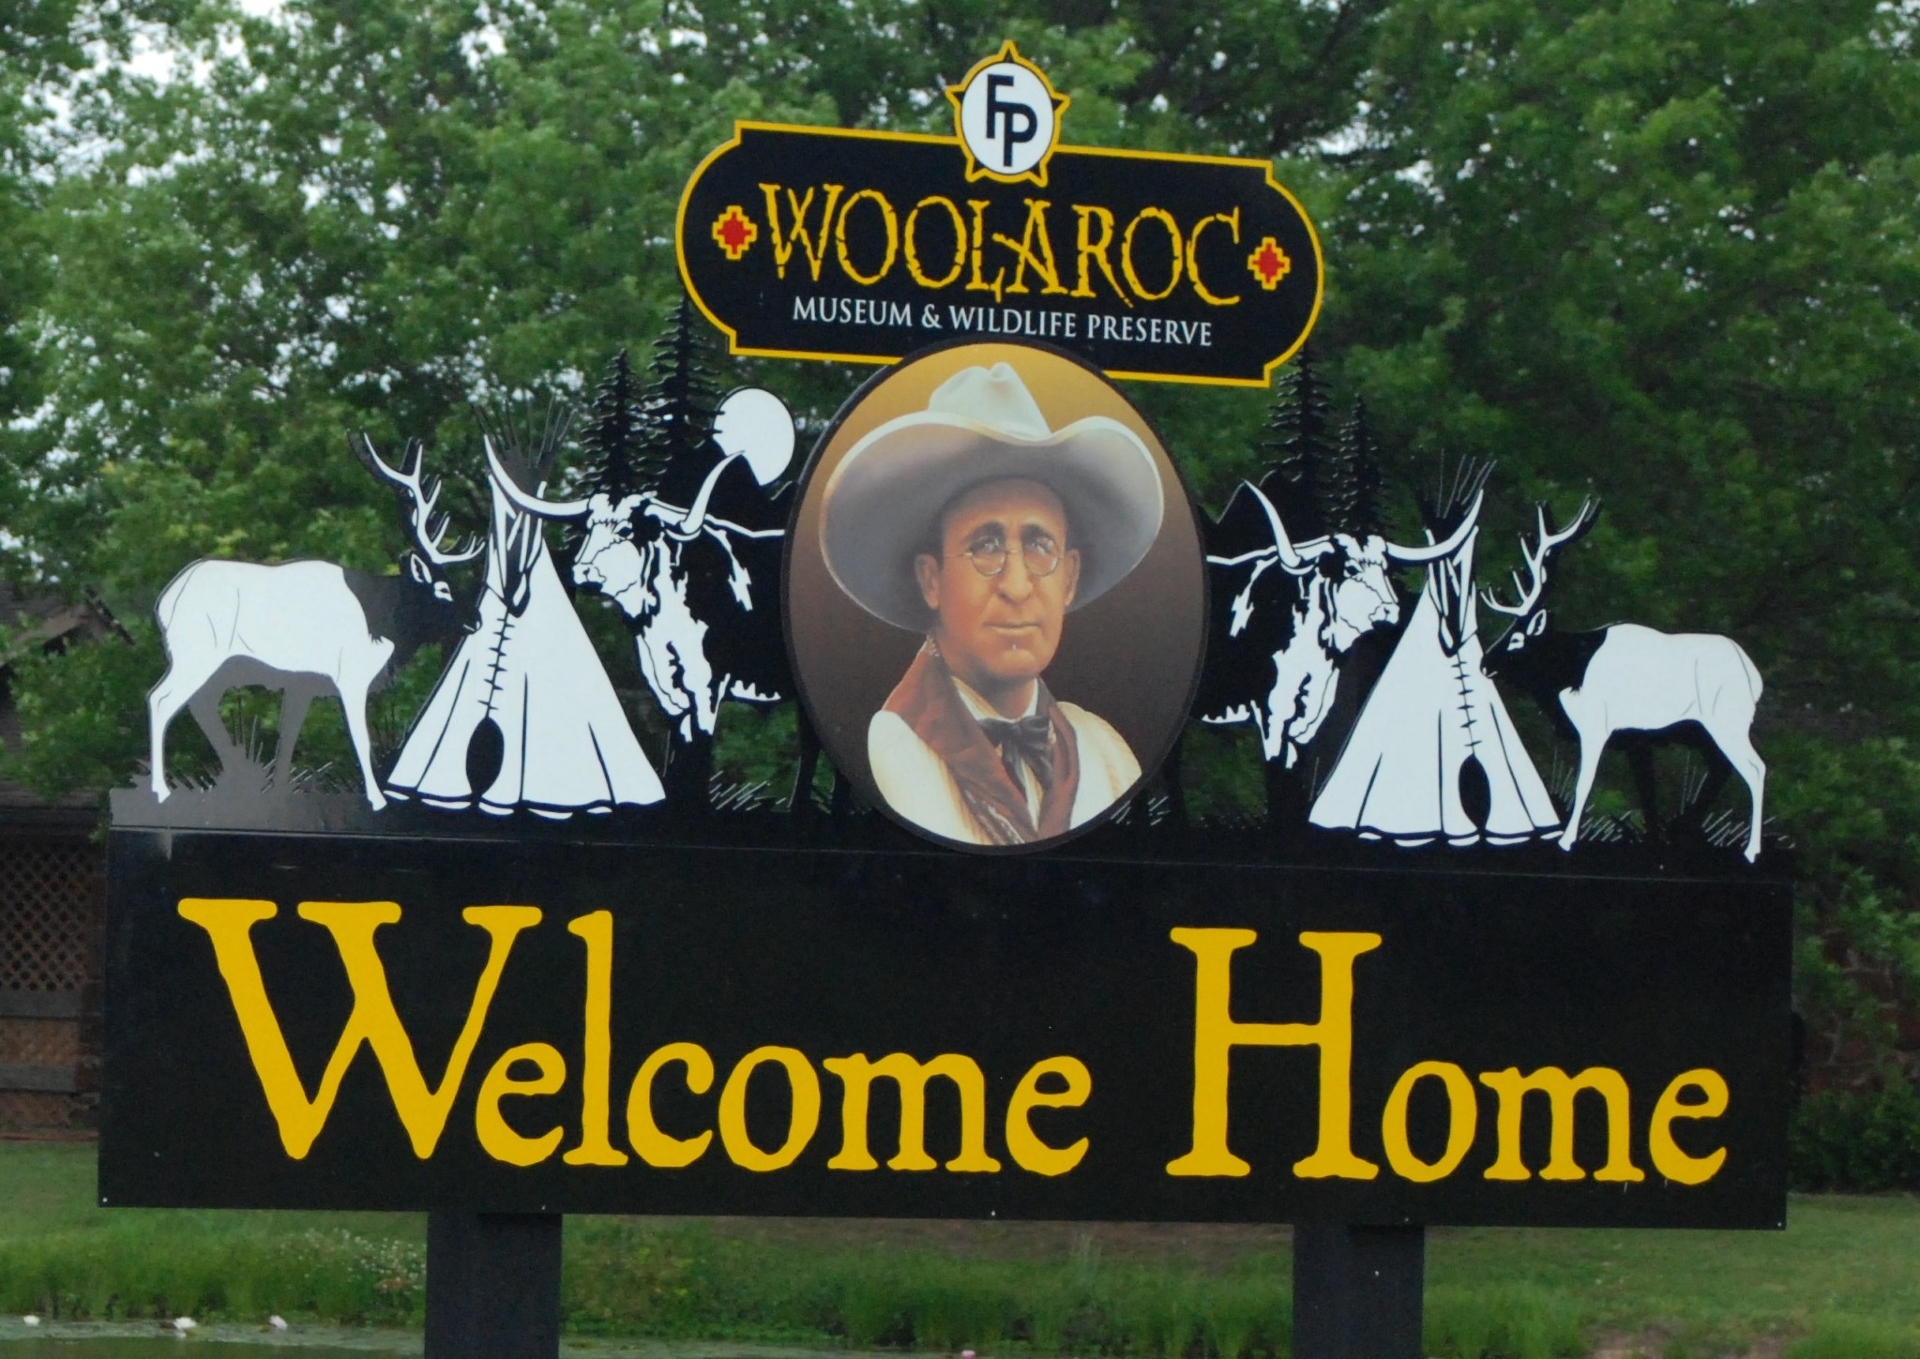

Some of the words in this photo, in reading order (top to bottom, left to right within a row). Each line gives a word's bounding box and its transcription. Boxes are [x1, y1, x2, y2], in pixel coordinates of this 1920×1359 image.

[986, 74, 1038, 167] FP
[758, 182, 1242, 307] WOOLAROC
[792, 295, 913, 327] MUSEUM
[920, 303, 942, 329] &
[949, 305, 1077, 338] WILDLIFE
[1087, 315, 1213, 347] PRESERVE
[177, 898, 1092, 1176] Welcome
[1165, 927, 1730, 1185] Home
